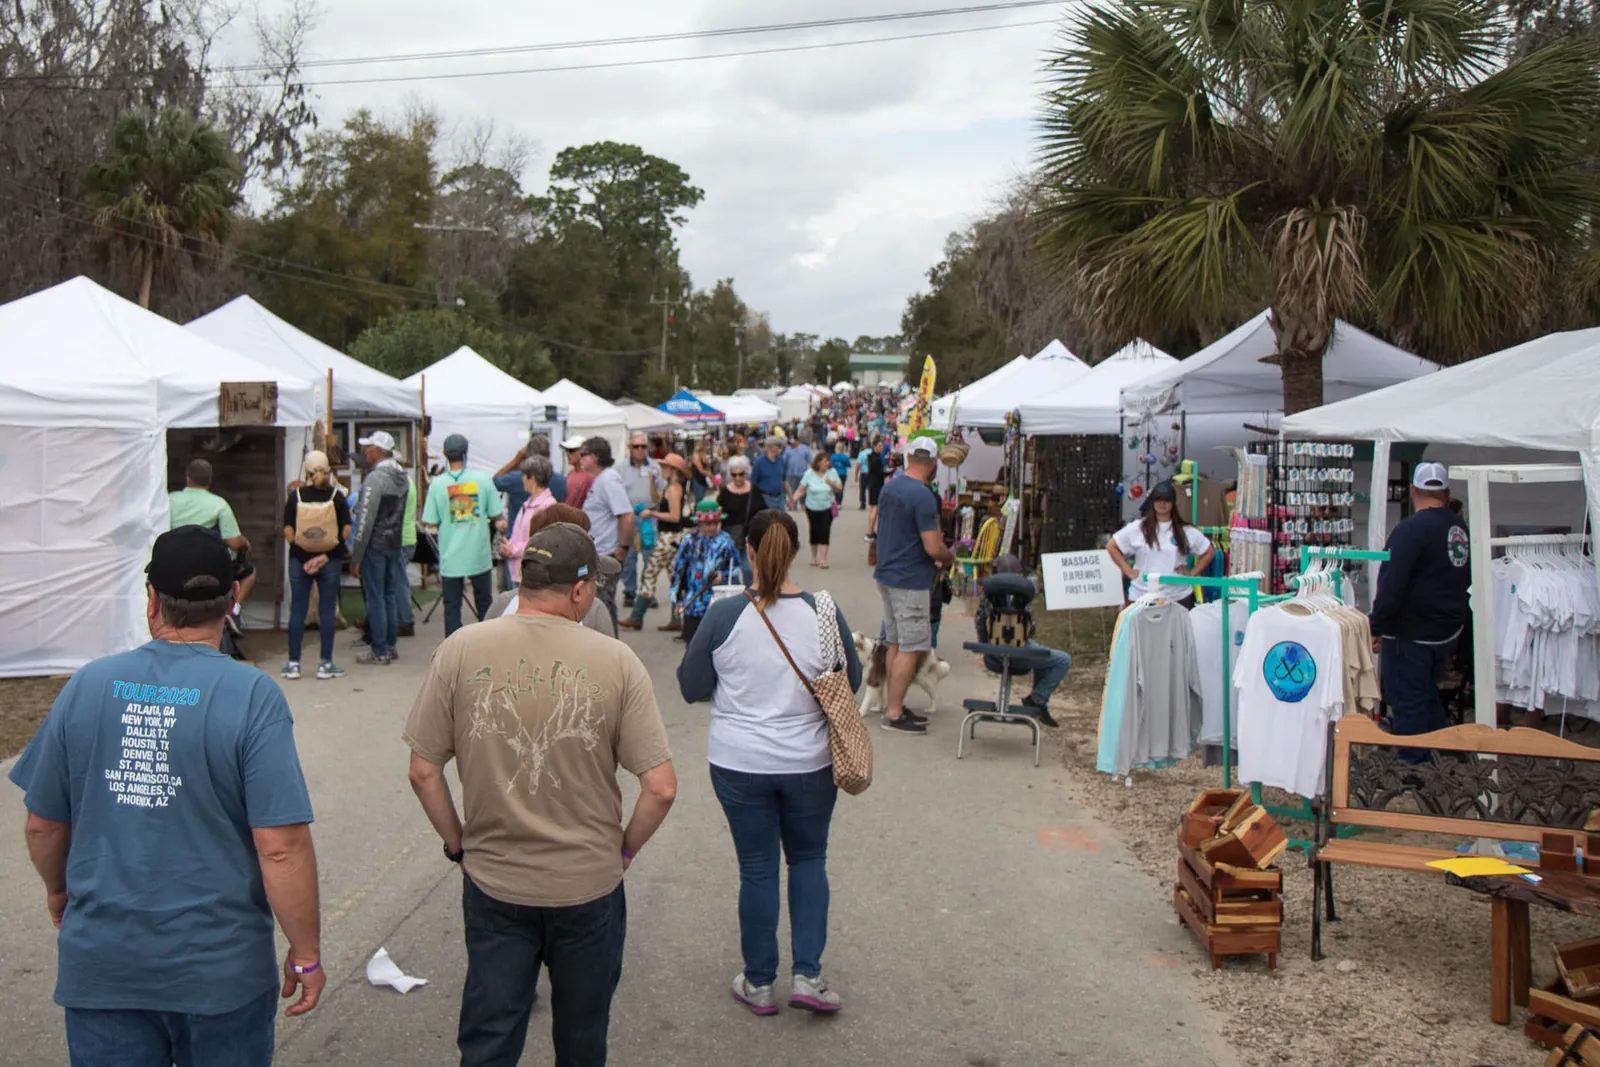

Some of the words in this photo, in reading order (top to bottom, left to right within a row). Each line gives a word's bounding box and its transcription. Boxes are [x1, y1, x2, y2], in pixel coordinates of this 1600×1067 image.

[1061, 555, 1100, 566] MASSAGE
[1088, 583, 1104, 593] FREE
[163, 706, 175, 716] GA
[121, 713, 143, 725] NEW
[163, 717, 177, 728] NY
[158, 729, 169, 739] TX
[160, 740, 170, 751] TX
[156, 751, 168, 761] CO
[119, 760, 133, 770] ST.
[156, 763, 169, 773] MN
[105, 769, 121, 781] SAN
[171, 776, 182, 787] CA
[109, 781, 125, 792] LOS
[126, 782, 166, 796] ANGELES,
[167, 786, 177, 797] CA
[155, 796, 169, 807] AZ
